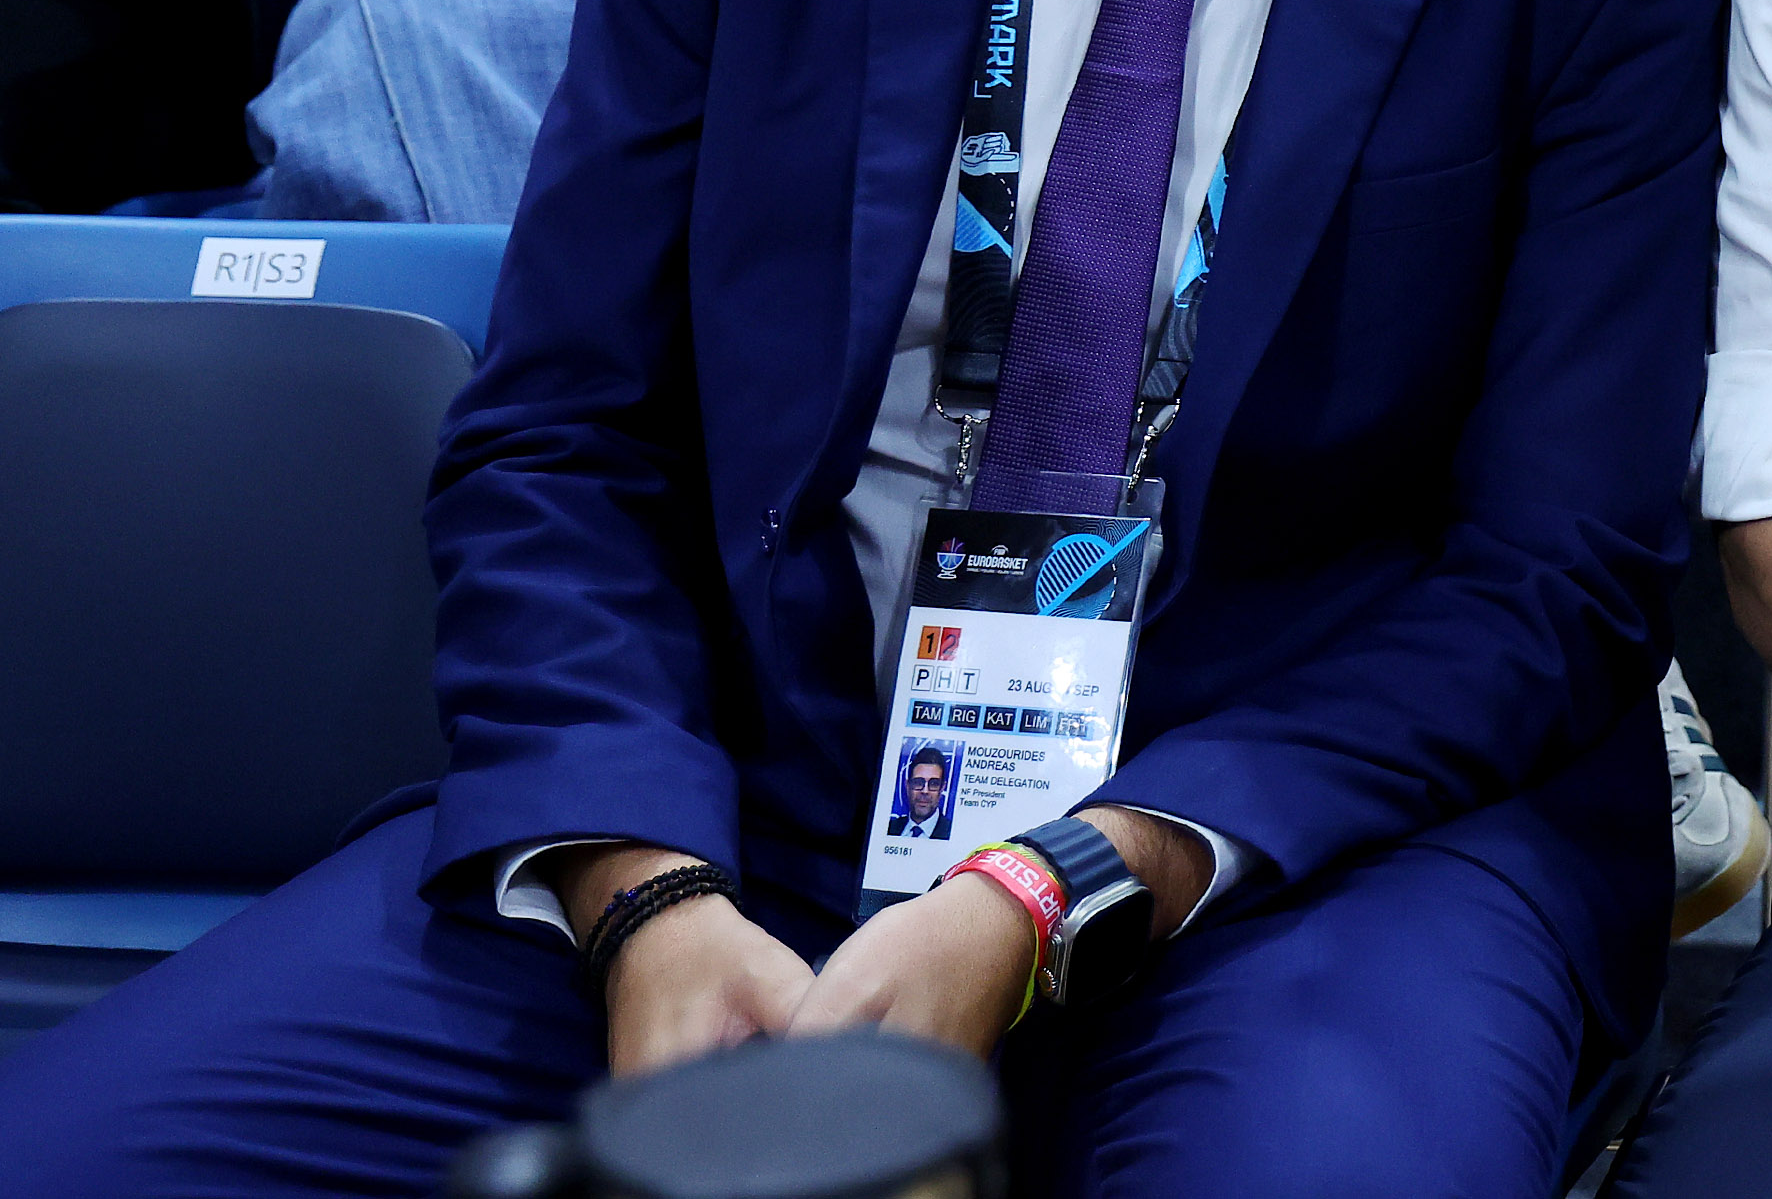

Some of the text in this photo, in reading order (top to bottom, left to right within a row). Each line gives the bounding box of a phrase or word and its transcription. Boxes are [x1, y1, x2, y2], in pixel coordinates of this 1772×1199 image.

[967, 554, 1029, 570] EUROBASKET
[926, 632, 957, 654] 1 2
[916, 669, 976, 690] P H T
[1007, 679, 1022, 692] 23
[1024, 680, 1050, 693] AUG
[1074, 683, 1100, 697] SEP
[915, 706, 942, 721] TAM
[952, 708, 976, 724] RIG
[986, 711, 1013, 726] KAT
[1024, 714, 1048, 729] LIM
[967, 746, 1046, 761] MOUZOURIDES
[965, 759, 1016, 772] ANDREAS
[964, 774, 1050, 790] TEAM DELEGATION
[960, 797, 997, 808] Team CYP
